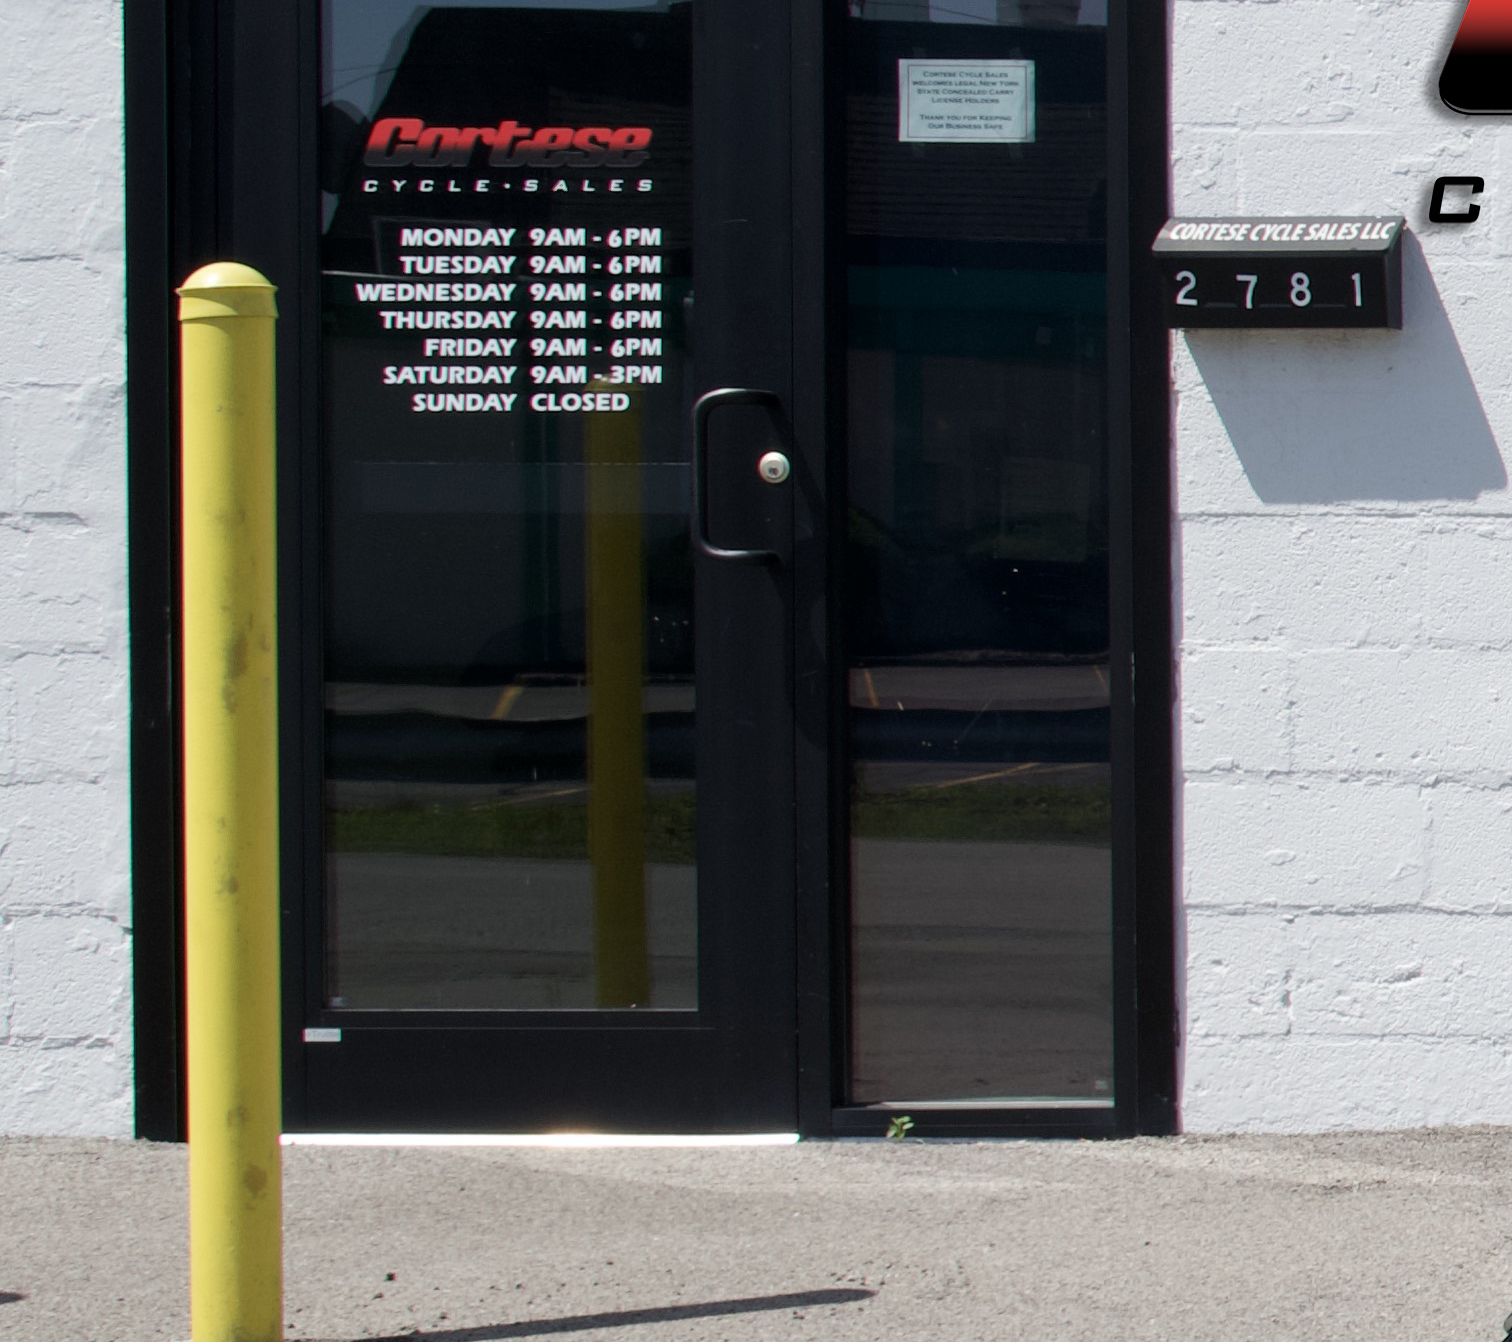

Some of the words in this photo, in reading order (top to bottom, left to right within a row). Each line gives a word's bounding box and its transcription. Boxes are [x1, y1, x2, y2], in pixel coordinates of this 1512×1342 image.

[364, 118, 652, 168] Cortese
[363, 179, 490, 192] CYCLE
[523, 179, 652, 192] SALES
[401, 228, 516, 247] MONDAY
[530, 228, 586, 247] 9AM
[608, 228, 662, 248] 6PM
[1170, 223, 1250, 241] CORTESE
[1250, 223, 1303, 241] CYCLE
[1304, 223, 1360, 241] SALES
[1360, 222, 1396, 240] LLC
[400, 256, 516, 274] TUESDAY
[530, 256, 586, 274] 9AM
[608, 256, 662, 275] 6PM
[356, 283, 516, 301] WEDNESDAY
[530, 283, 586, 301] 9AM
[608, 283, 662, 302] 6PM
[380, 311, 516, 329] THURSDAY
[530, 311, 586, 329] 9AM
[608, 311, 662, 330] 6PM
[424, 338, 516, 356] FRIDAY
[530, 338, 586, 356] 9AM
[608, 338, 662, 357] 6PM
[383, 366, 516, 384] SATURDAY
[530, 366, 586, 384] 9AM
[608, 366, 662, 385] 3PM
[412, 393, 516, 412] SUNDAY
[531, 393, 630, 412] CLOSED
